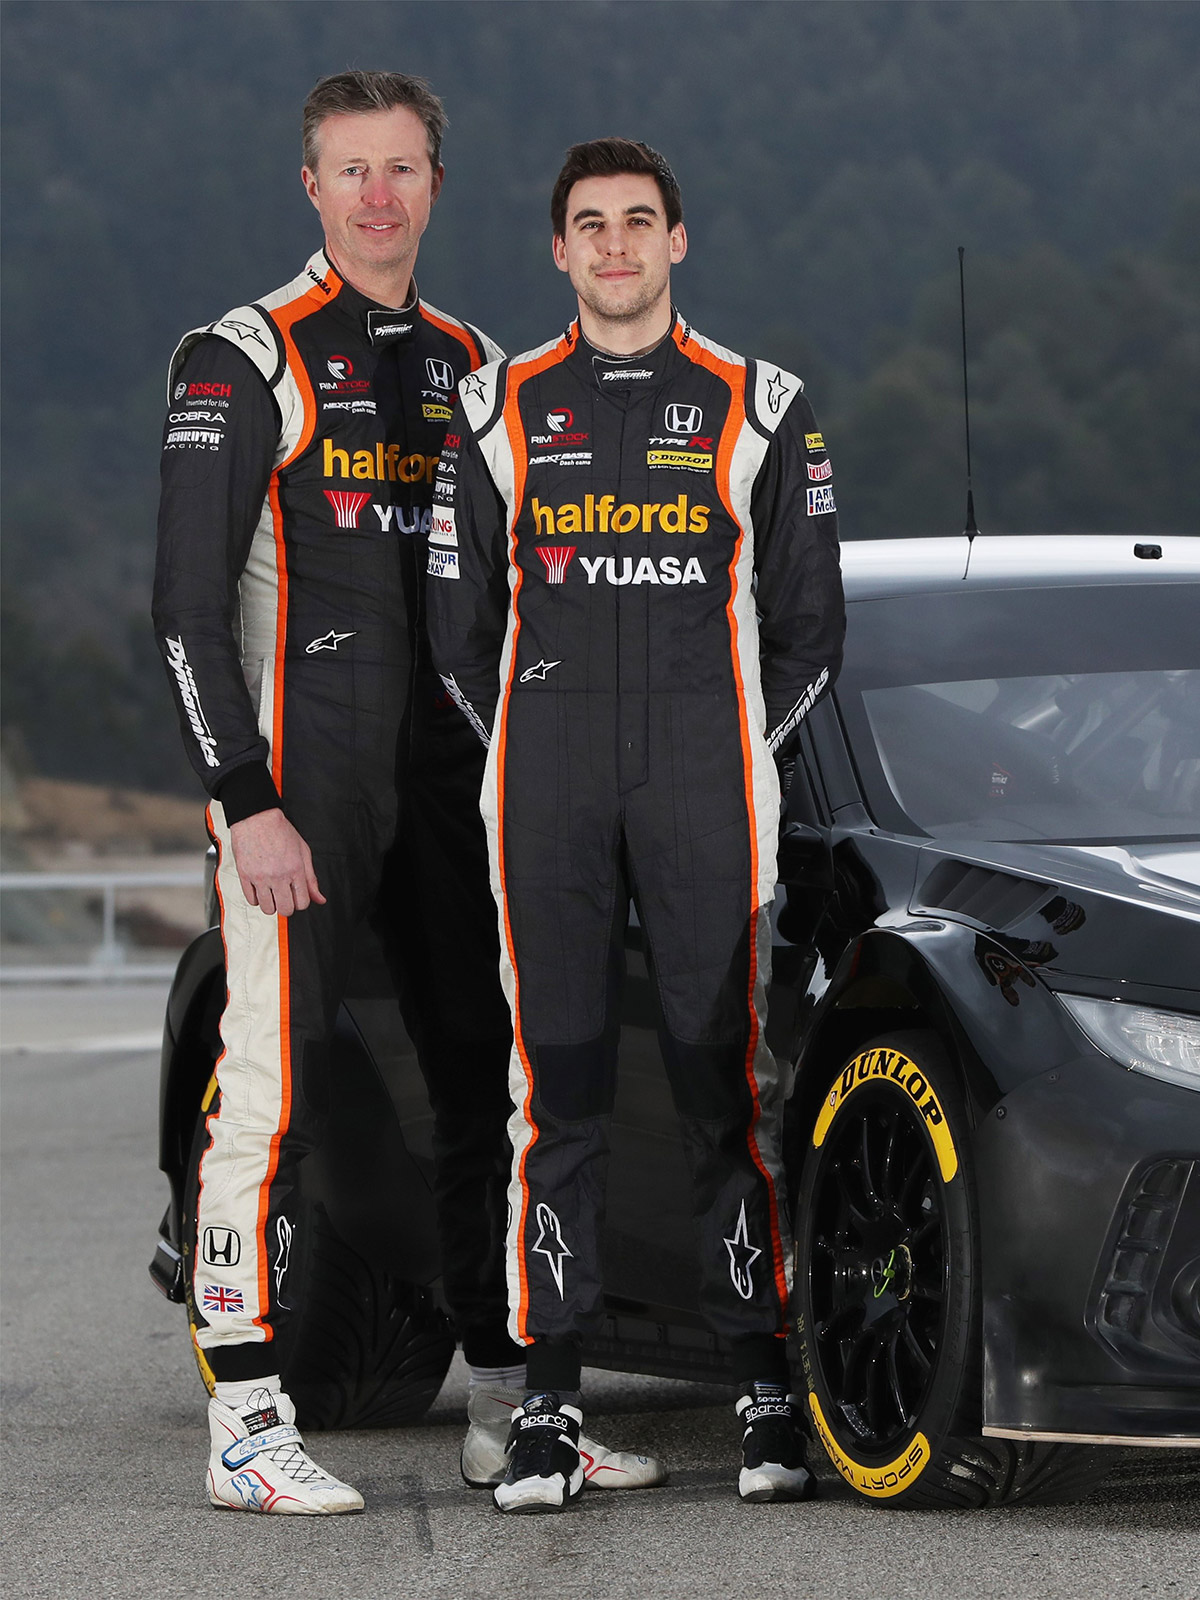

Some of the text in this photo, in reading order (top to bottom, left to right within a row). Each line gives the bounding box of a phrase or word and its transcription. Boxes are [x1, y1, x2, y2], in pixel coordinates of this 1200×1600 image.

[307, 269, 332, 295] YUASA
[188, 382, 232, 397] BOSCH
[208, 399, 218, 407] for
[218, 400, 230, 408] life
[169, 411, 226, 423] COBRA
[531, 433, 589, 444] RIMSTOCK
[649, 435, 713, 450] TYPE R
[660, 454, 710, 465] DUNLOP
[531, 494, 711, 536] halfords
[578, 556, 708, 586] YUASA
[165, 635, 220, 767] Dynamics
[840, 1050, 943, 1126] DUNLOP
[745, 1404, 791, 1420] sparco
[521, 1414, 568, 1428] sparco
[860, 1443, 924, 1490] SPORT
